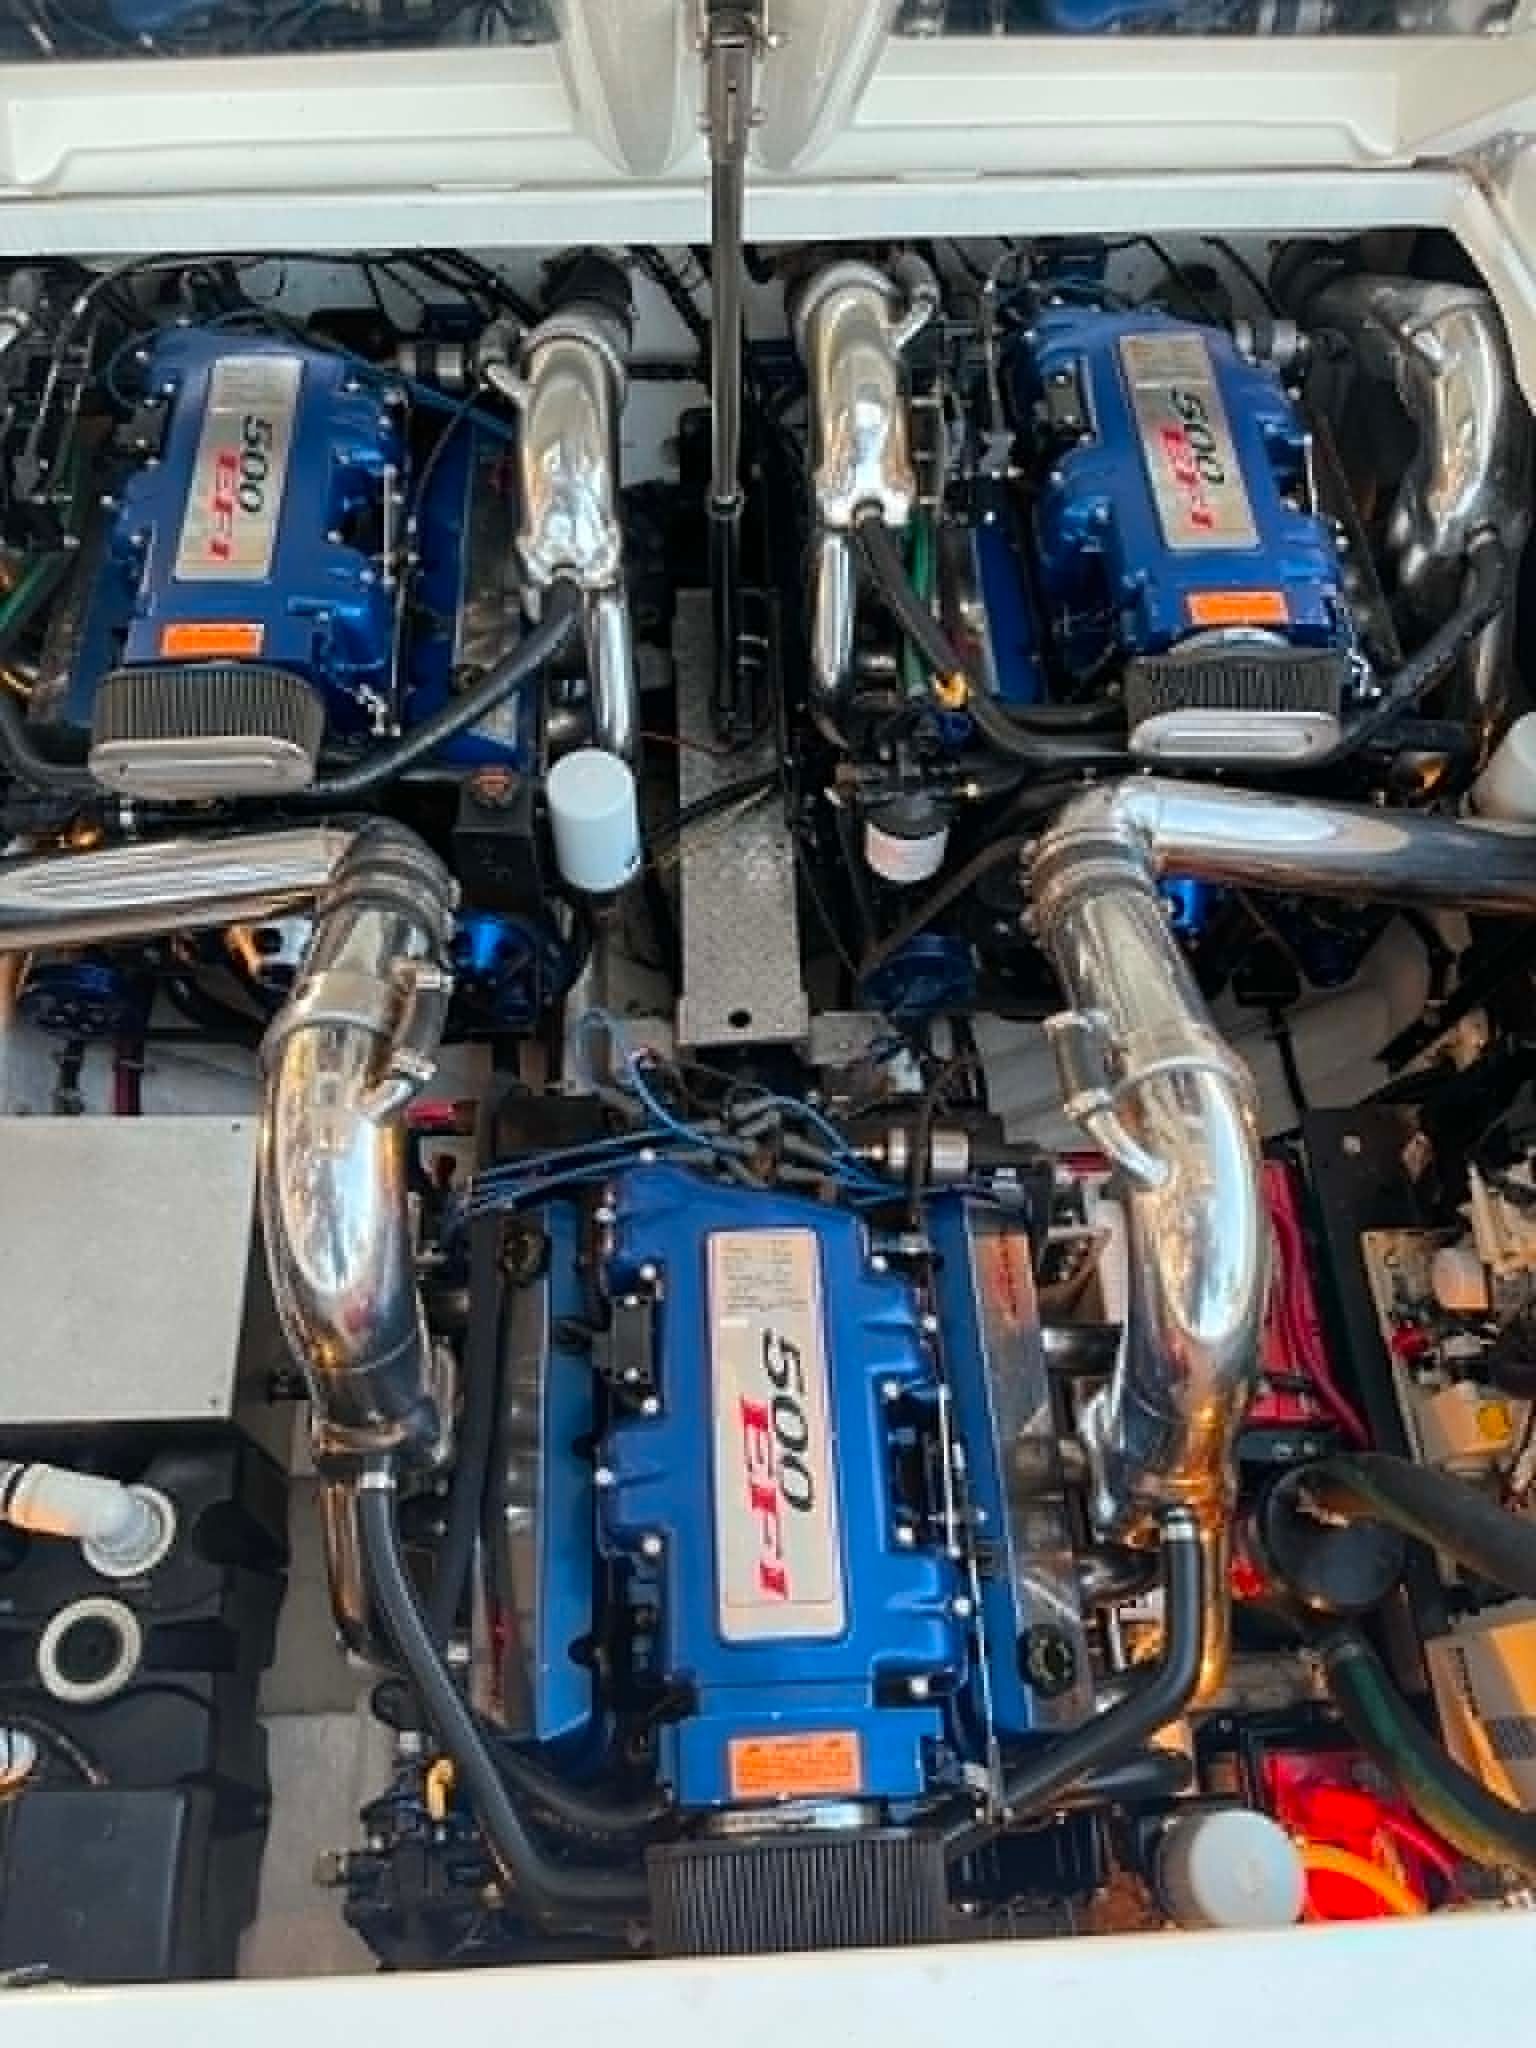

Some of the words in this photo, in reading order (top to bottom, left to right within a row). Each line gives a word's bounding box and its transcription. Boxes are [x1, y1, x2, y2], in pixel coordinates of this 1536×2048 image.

[240, 414, 273, 512] 500
[1171, 385, 1226, 484] 500
[762, 1327, 815, 1513] 500
[739, 1393, 790, 1600] EFI
